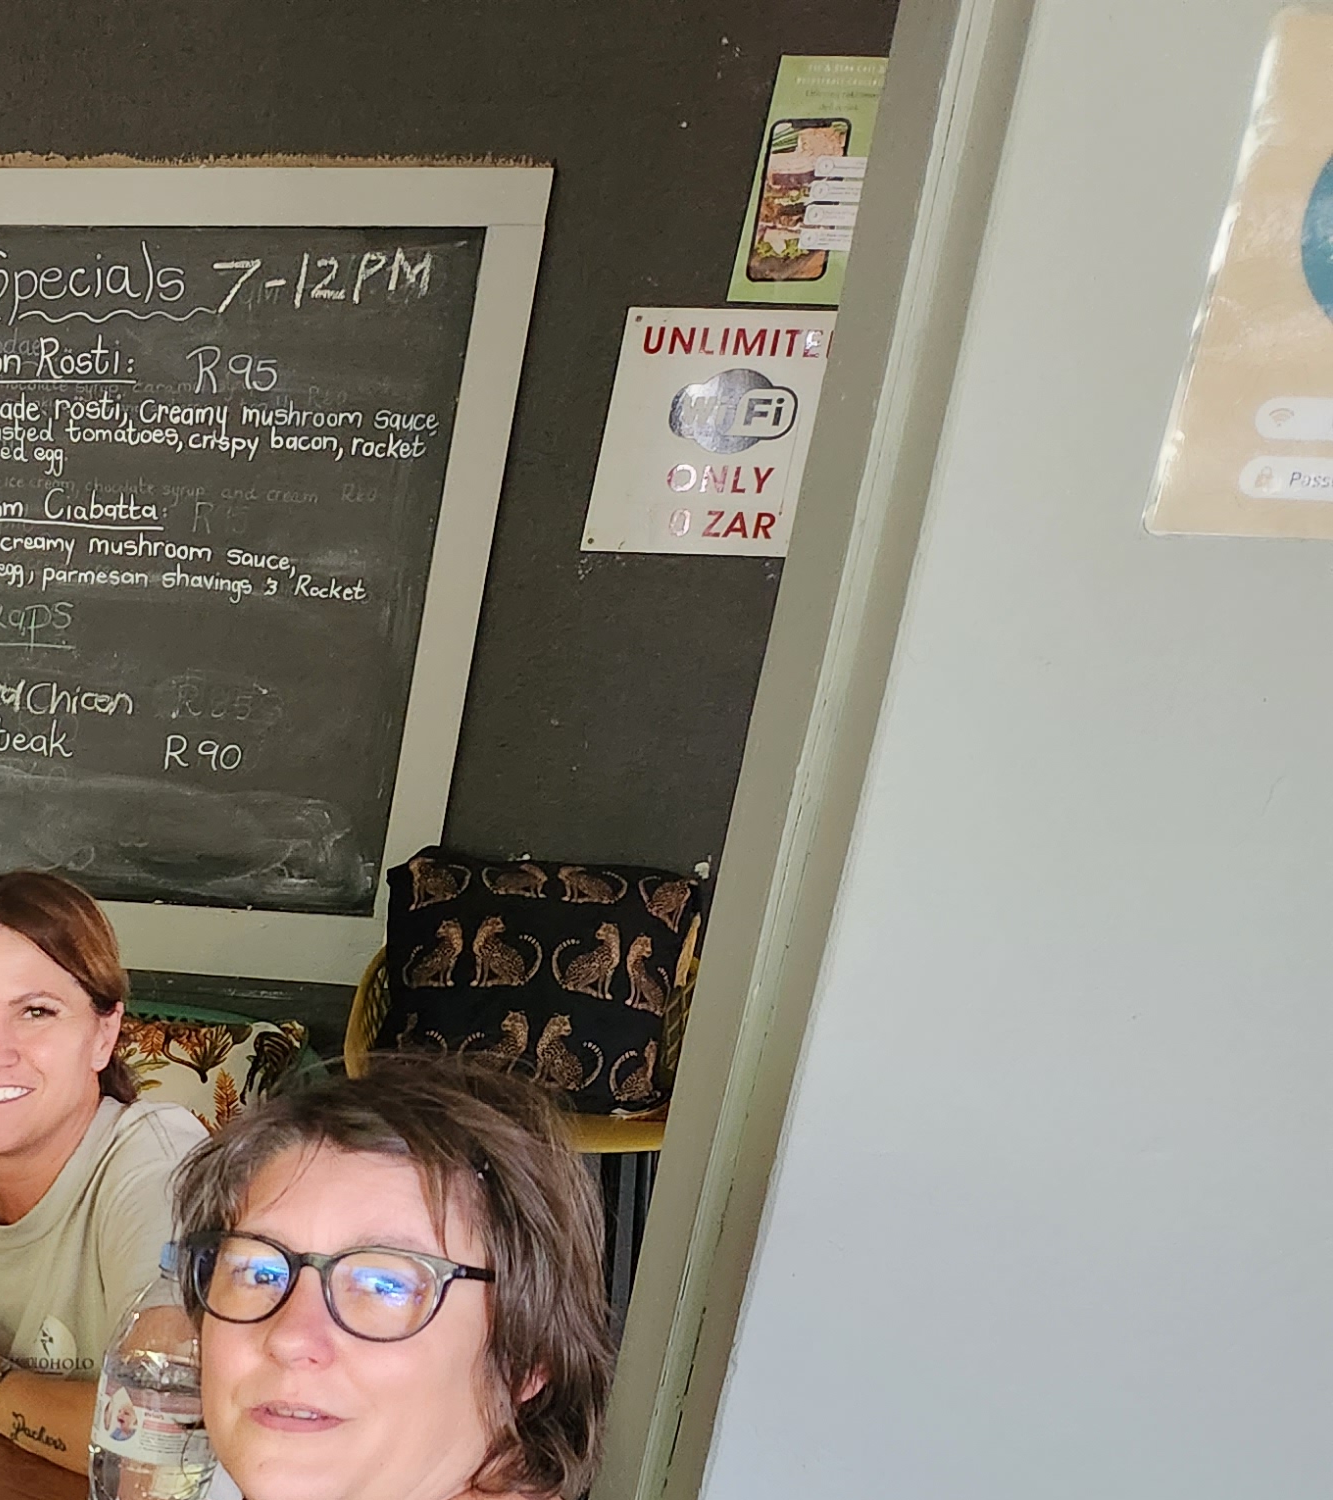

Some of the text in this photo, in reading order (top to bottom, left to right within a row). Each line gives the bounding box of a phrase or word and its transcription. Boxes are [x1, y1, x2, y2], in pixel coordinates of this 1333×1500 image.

[643, 326, 834, 359] UNLIMITE
[242, 400, 363, 429] mushroom
[65, 421, 183, 453] tomatoes,
[188, 428, 260, 461] crispy
[271, 427, 344, 461] bacon,
[350, 432, 427, 459] rocket
[666, 464, 775, 494] ONLY
[1289, 471, 1333, 488] Pass
[702, 510, 776, 539] ZAR
[0, 536, 75, 562] creamy
[89, 532, 212, 563] mushroom
[42, 566, 149, 592] parmesan
[161, 570, 253, 604] shavings
[293, 573, 367, 602] Rocket
